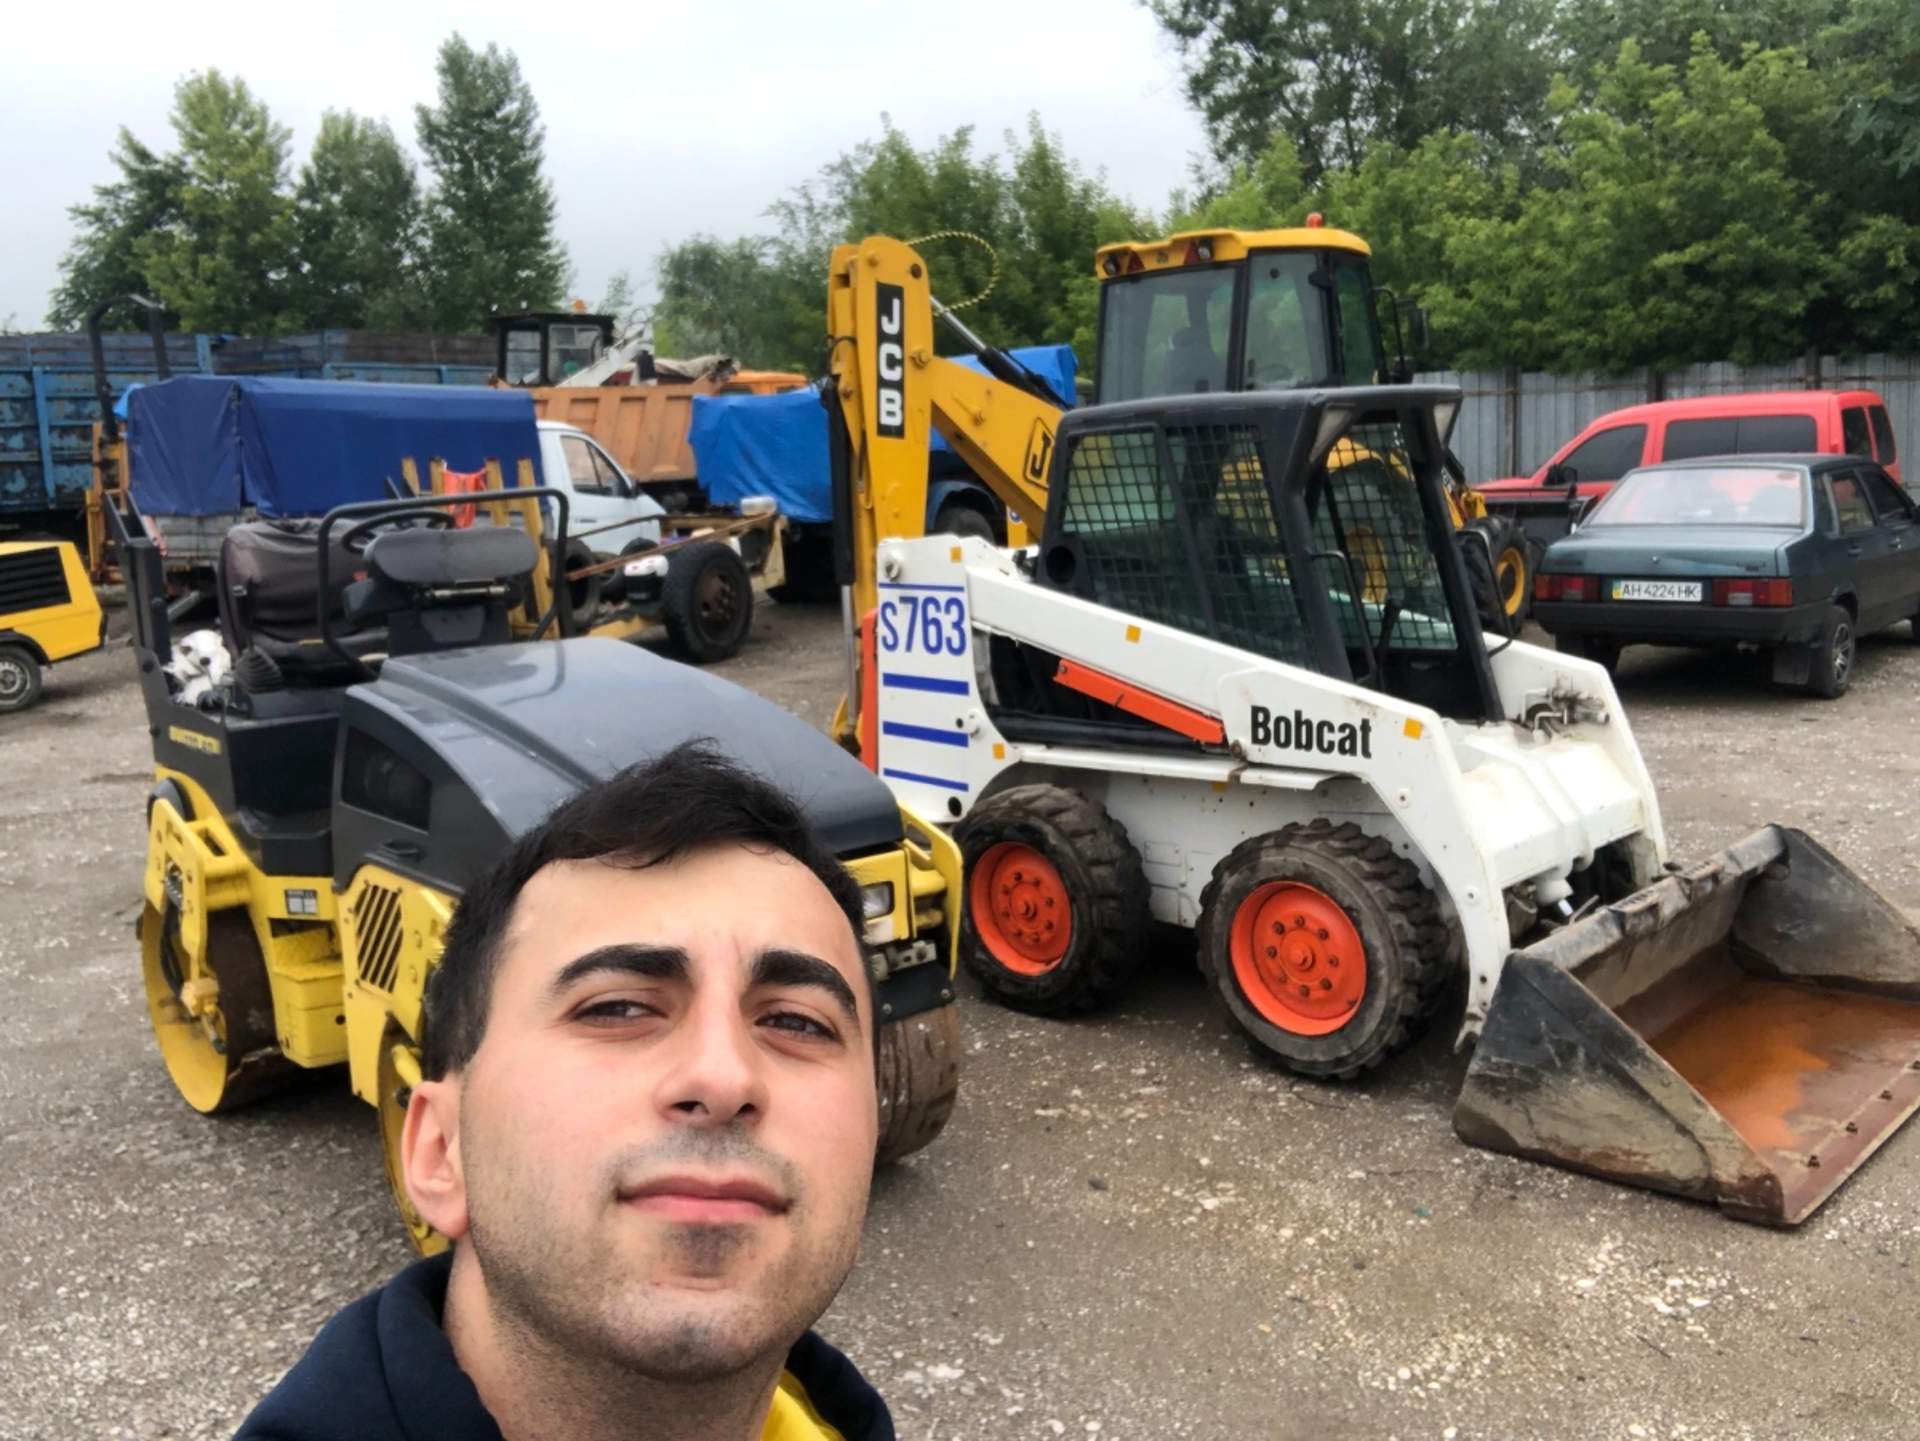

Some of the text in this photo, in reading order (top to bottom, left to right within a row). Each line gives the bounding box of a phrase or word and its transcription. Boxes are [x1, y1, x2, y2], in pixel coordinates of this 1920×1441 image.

[879, 298, 903, 426] JCB
[1622, 583, 1641, 597] AH
[1644, 584, 1675, 598] 4224
[880, 596, 967, 656] S763
[1251, 705, 1372, 759] Bobcat
